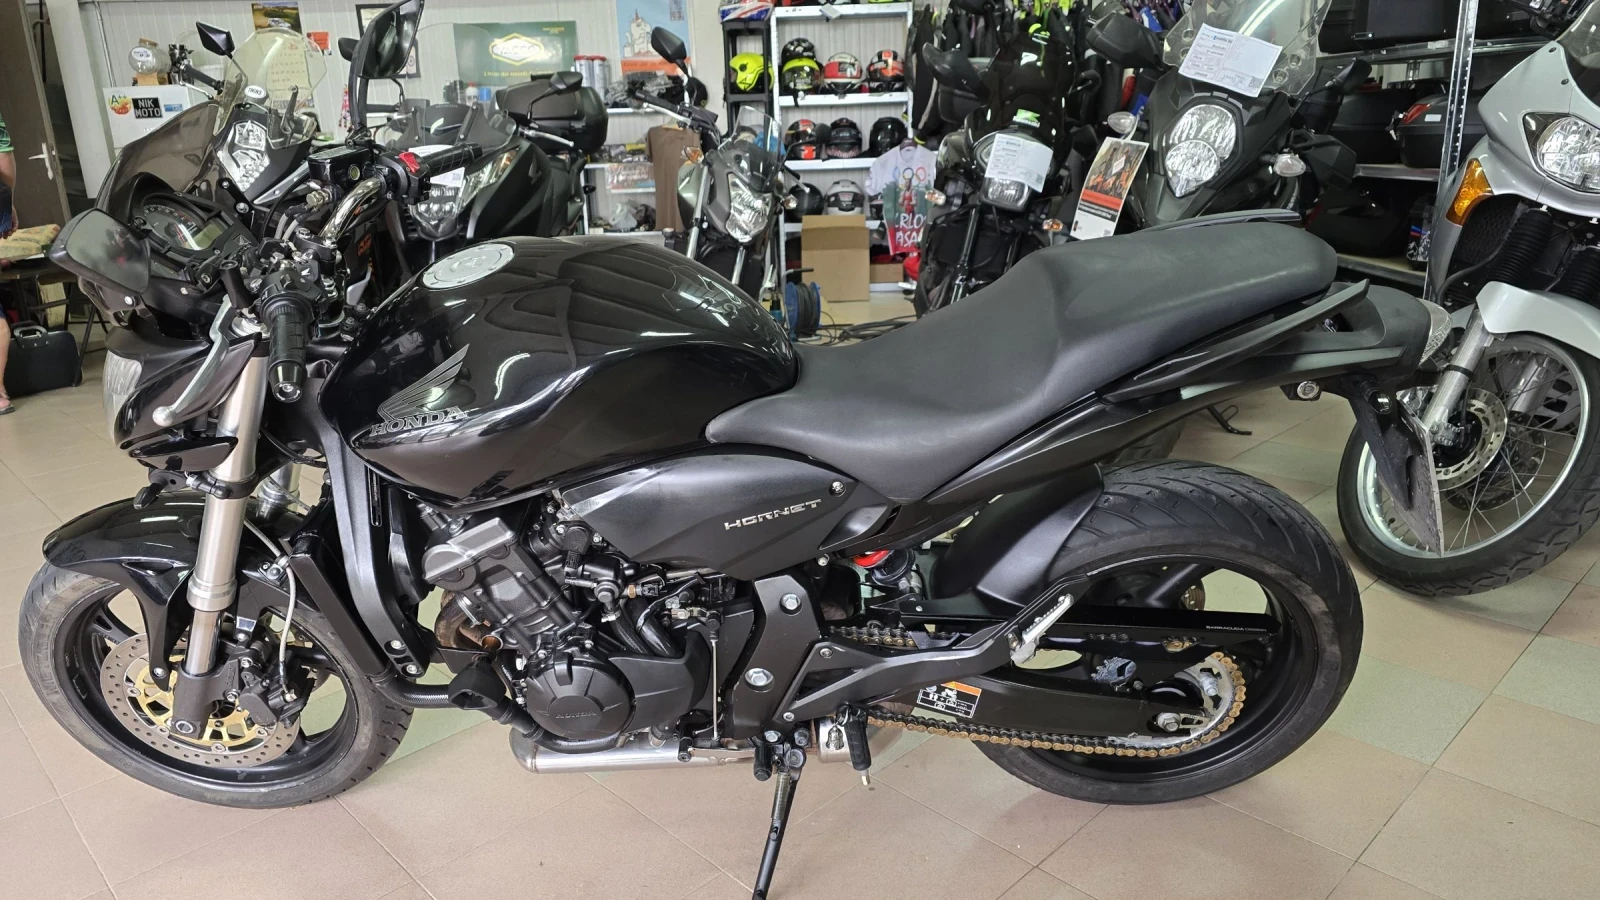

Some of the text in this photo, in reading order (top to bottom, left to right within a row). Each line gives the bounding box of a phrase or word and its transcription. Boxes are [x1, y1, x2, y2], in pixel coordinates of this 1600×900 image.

[138, 98, 154, 109] NIK
[135, 108, 161, 118] MOTO
[895, 212, 927, 229] RLO
[368, 405, 467, 437] HONDA
[723, 498, 822, 531] HORNET
